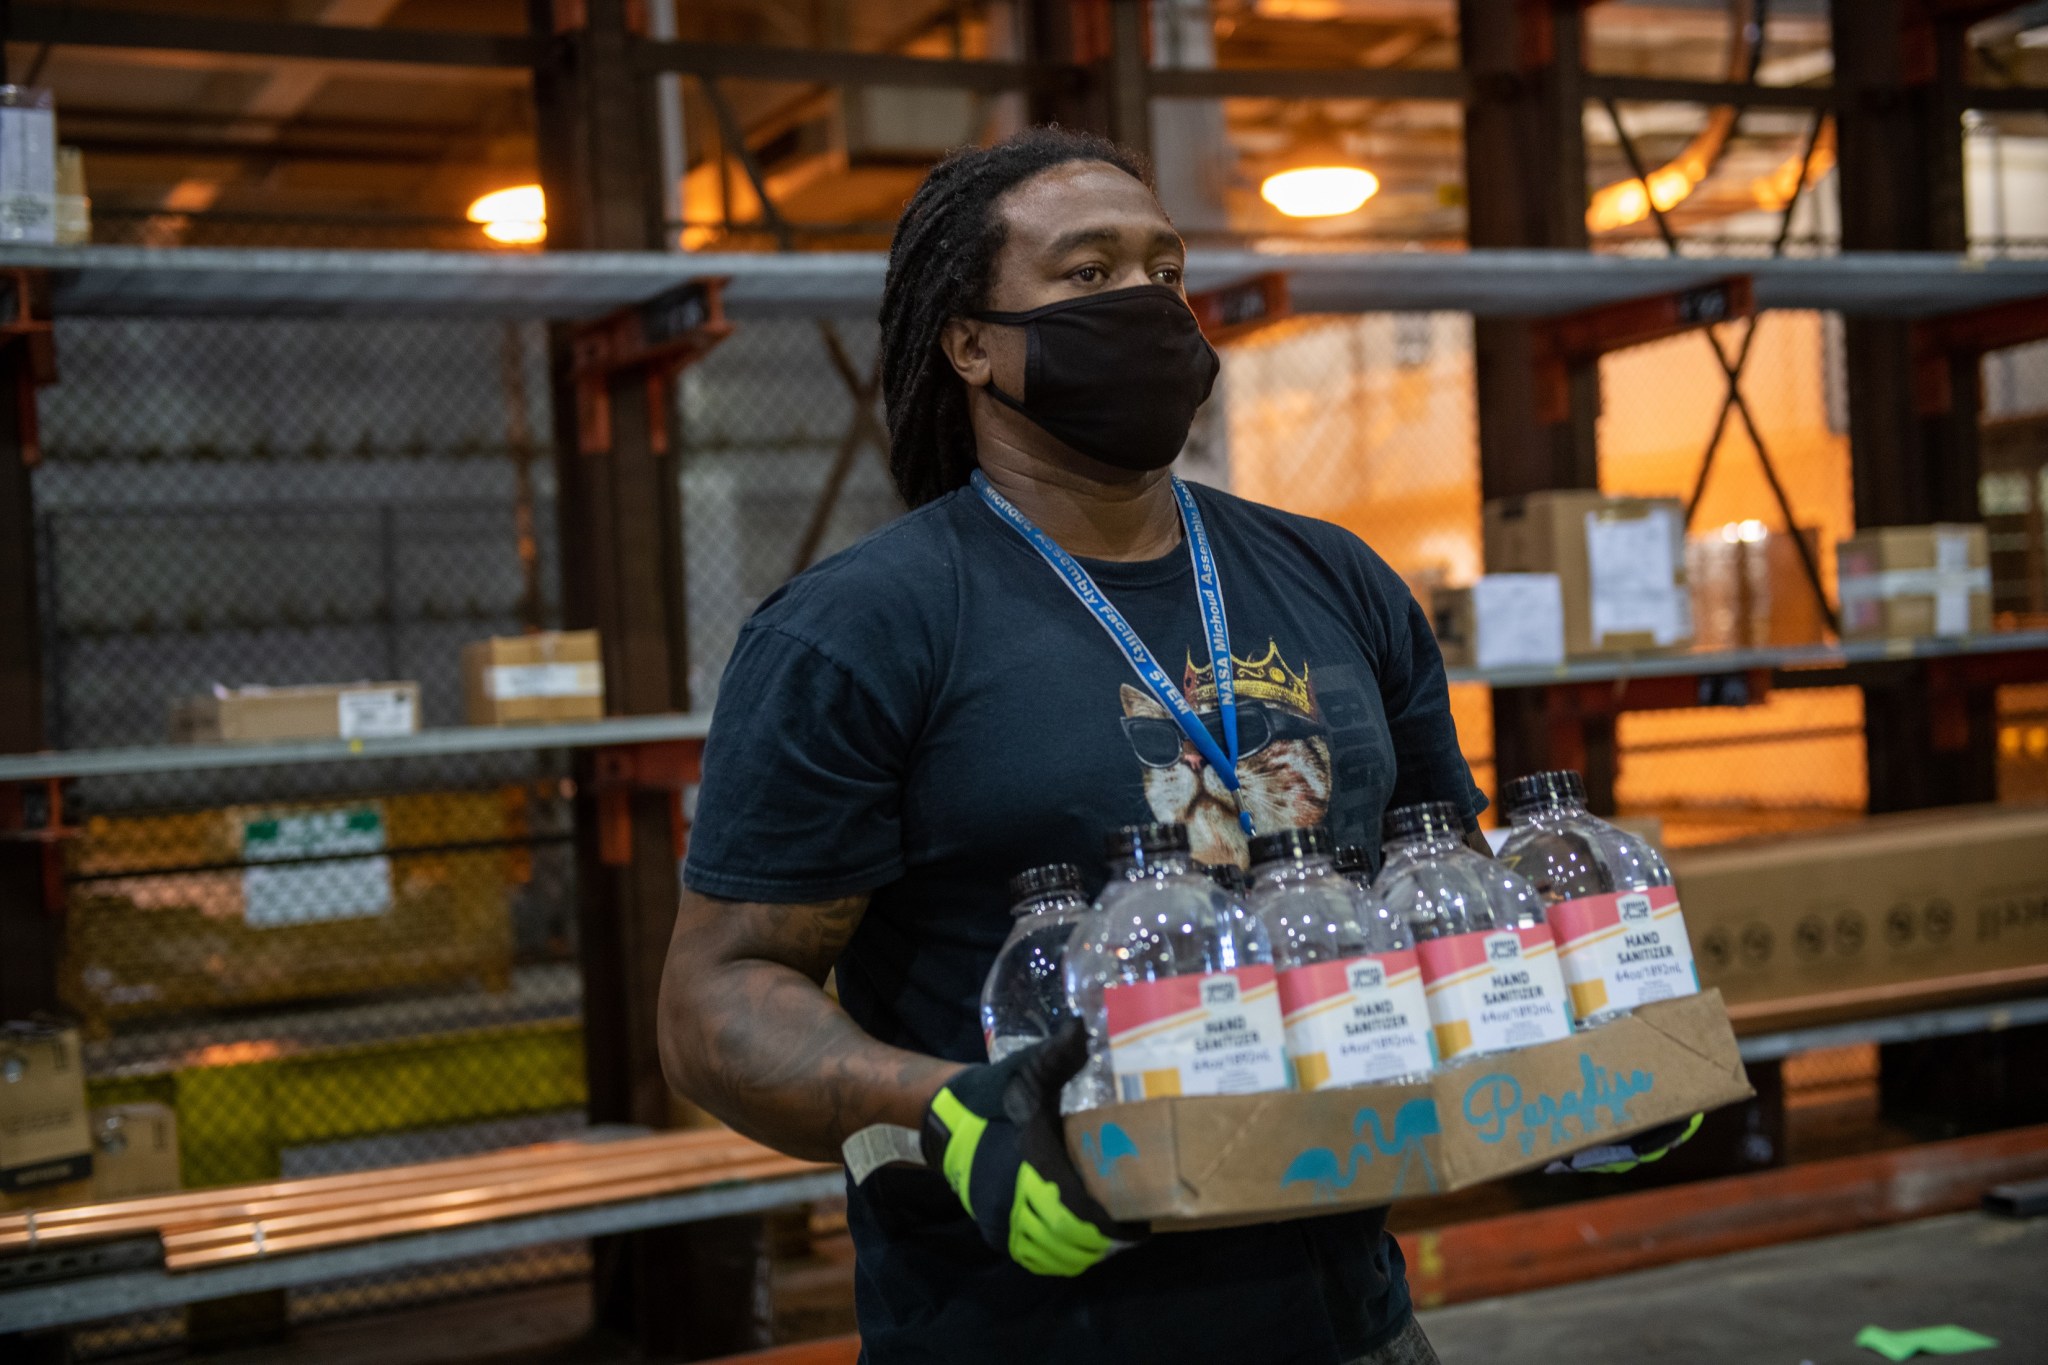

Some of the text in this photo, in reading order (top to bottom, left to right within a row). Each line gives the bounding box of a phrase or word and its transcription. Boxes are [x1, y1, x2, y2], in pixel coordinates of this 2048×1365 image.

[1190, 512, 1213, 586] Assembly
[1209, 590, 1229, 652] Michoud
[1099, 604, 1148, 664] Facility
[1149, 669, 1190, 716] STEM
[1220, 655, 1235, 706] NASA
[1625, 931, 1660, 948] HAND
[1618, 945, 1674, 965] SANITIZER
[1491, 971, 1530, 987] HAND
[1483, 985, 1544, 1006] SANITIZER
[1353, 1000, 1394, 1017] HAND
[1205, 1015, 1247, 1034] HAND
[1344, 1014, 1409, 1036] SANITIZER
[1195, 1029, 1261, 1053] SANITIZER
[1462, 1053, 1654, 1144] Paradise
